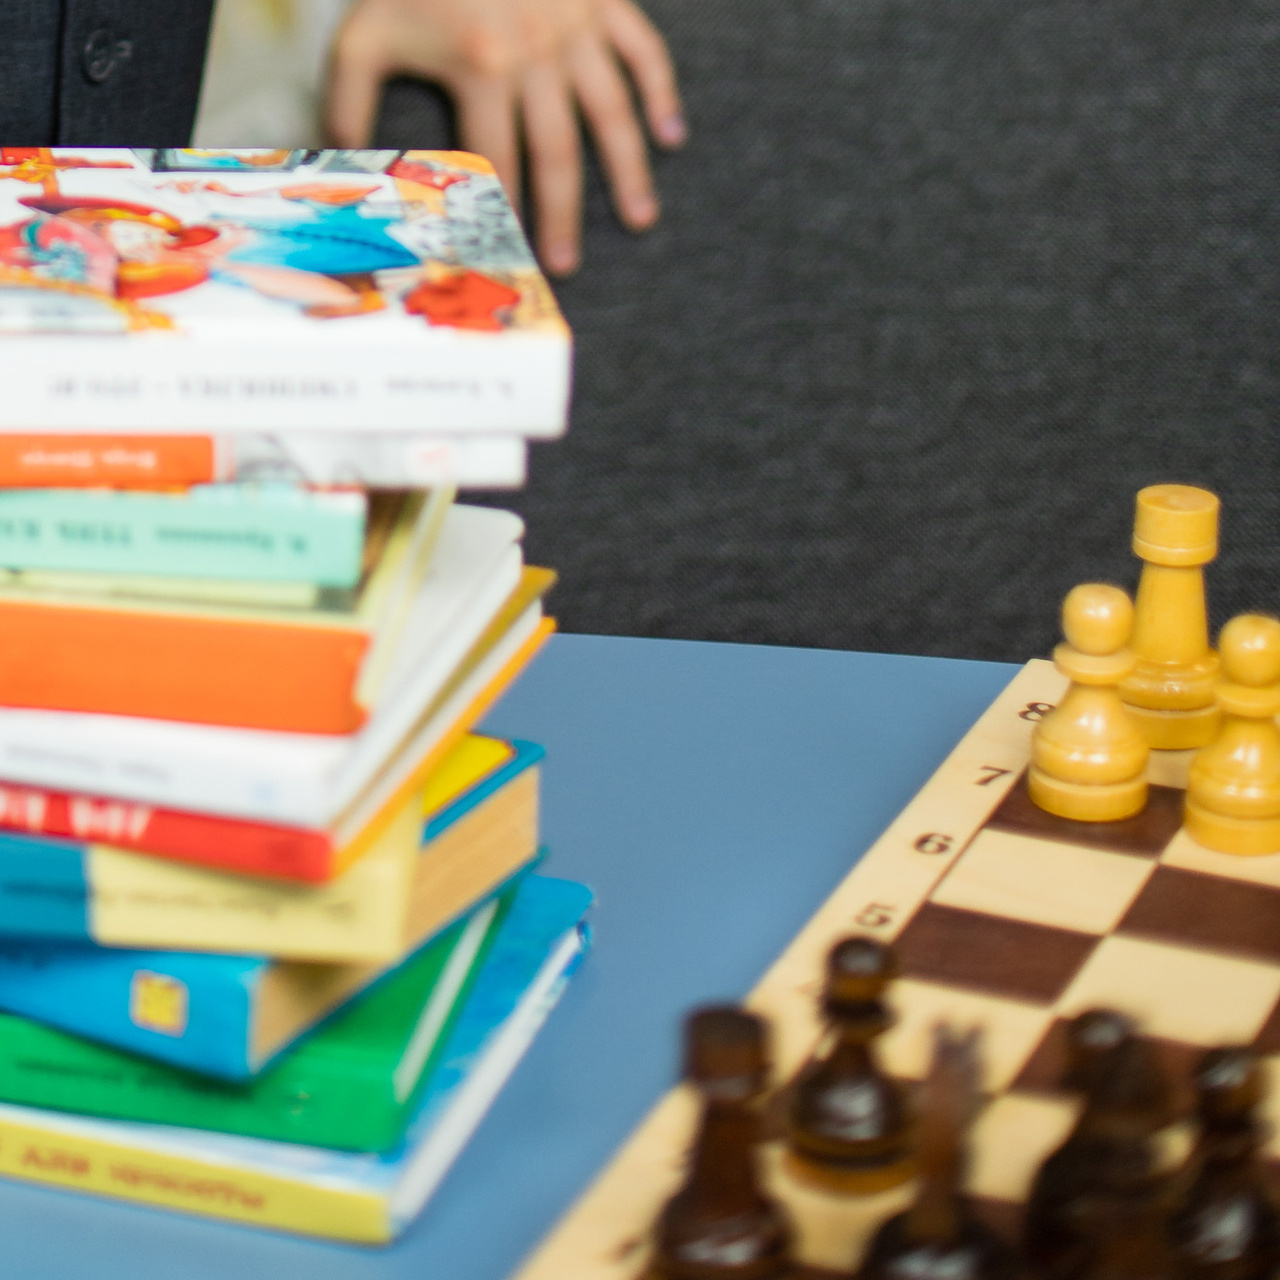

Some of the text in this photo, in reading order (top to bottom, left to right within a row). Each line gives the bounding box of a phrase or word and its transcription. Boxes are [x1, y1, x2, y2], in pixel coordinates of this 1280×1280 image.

[1018, 701, 1057, 722] 8
[974, 765, 1013, 787] 7
[912, 832, 954, 855] 6
[853, 902, 898, 928] 5
